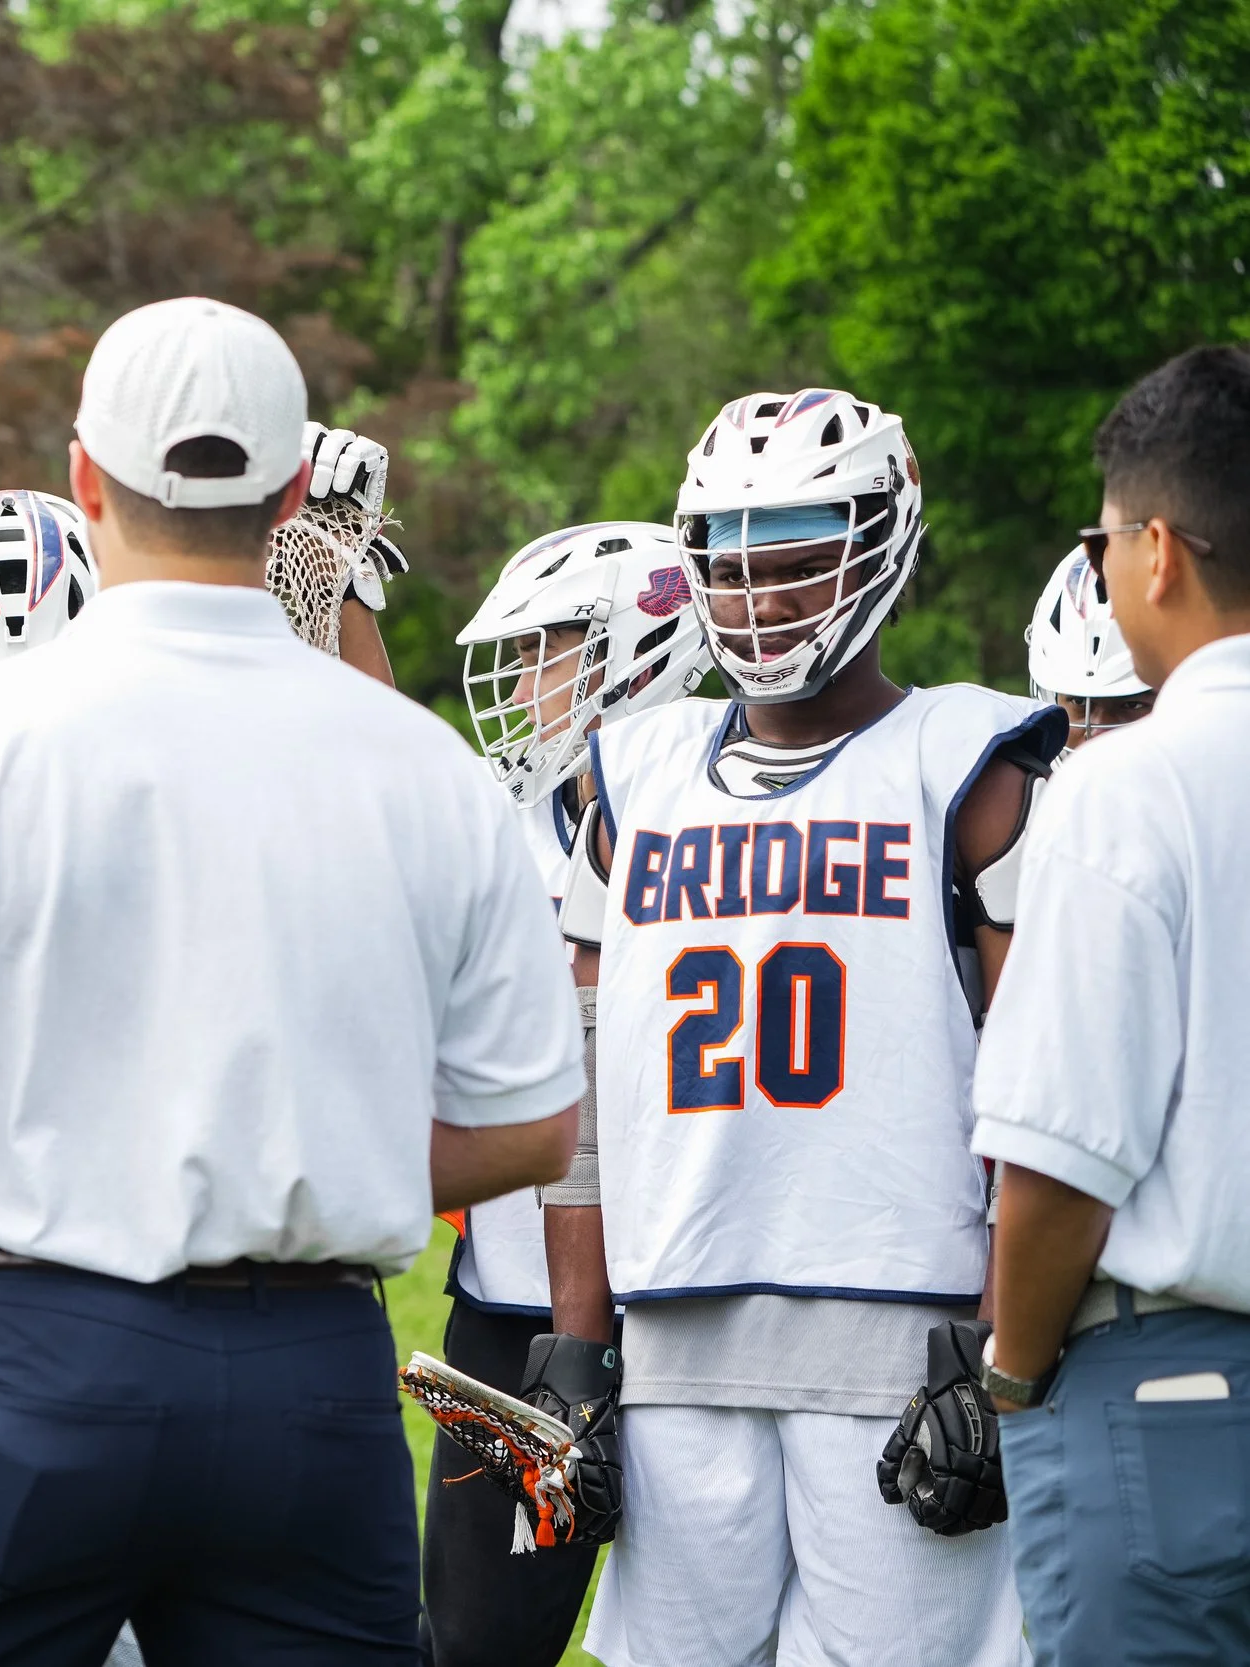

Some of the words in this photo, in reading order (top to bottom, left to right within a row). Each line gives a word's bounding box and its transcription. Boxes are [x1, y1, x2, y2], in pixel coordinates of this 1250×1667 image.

[751, 682, 792, 692] cascade
[622, 819, 911, 927] BRIDGE
[665, 941, 847, 1115] 20
